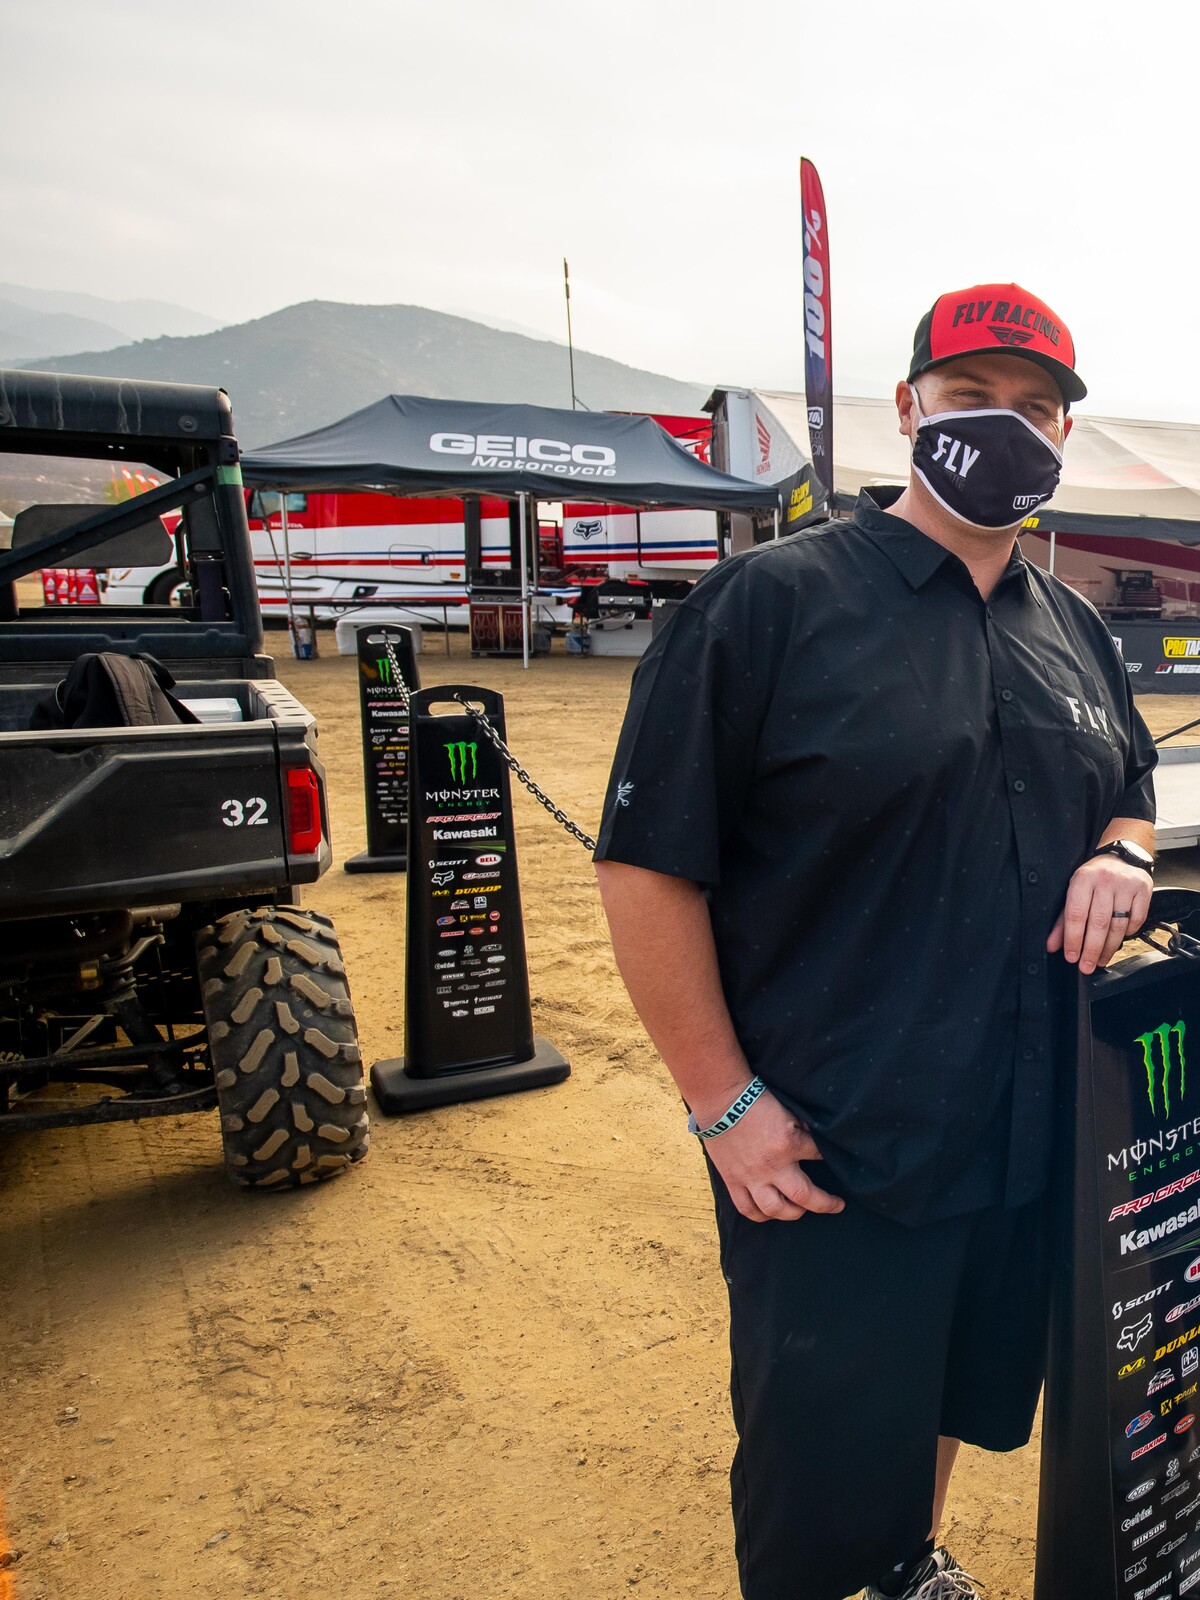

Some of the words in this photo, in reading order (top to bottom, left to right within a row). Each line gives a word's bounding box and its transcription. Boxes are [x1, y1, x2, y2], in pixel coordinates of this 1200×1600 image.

[952, 301, 991, 328] FLY
[992, 301, 1061, 347] RACING
[429, 432, 616, 466] GEICO
[931, 432, 981, 478] FLY
[471, 455, 617, 477] Motorcycle
[1065, 696, 1109, 735] FLY
[425, 788, 501, 802] MONSTER
[438, 800, 491, 808] ENERGY
[221, 797, 269, 827] 32
[433, 826, 498, 840] Kawasaki
[436, 859, 469, 867] SCOTT
[454, 885, 502, 896] DUNLOP
[700, 1121, 730, 1139] IELD
[1108, 1192, 1155, 1222] PRO
[1124, 1280, 1174, 1312] SCOTT
[1133, 1521, 1166, 1548] HINSON
